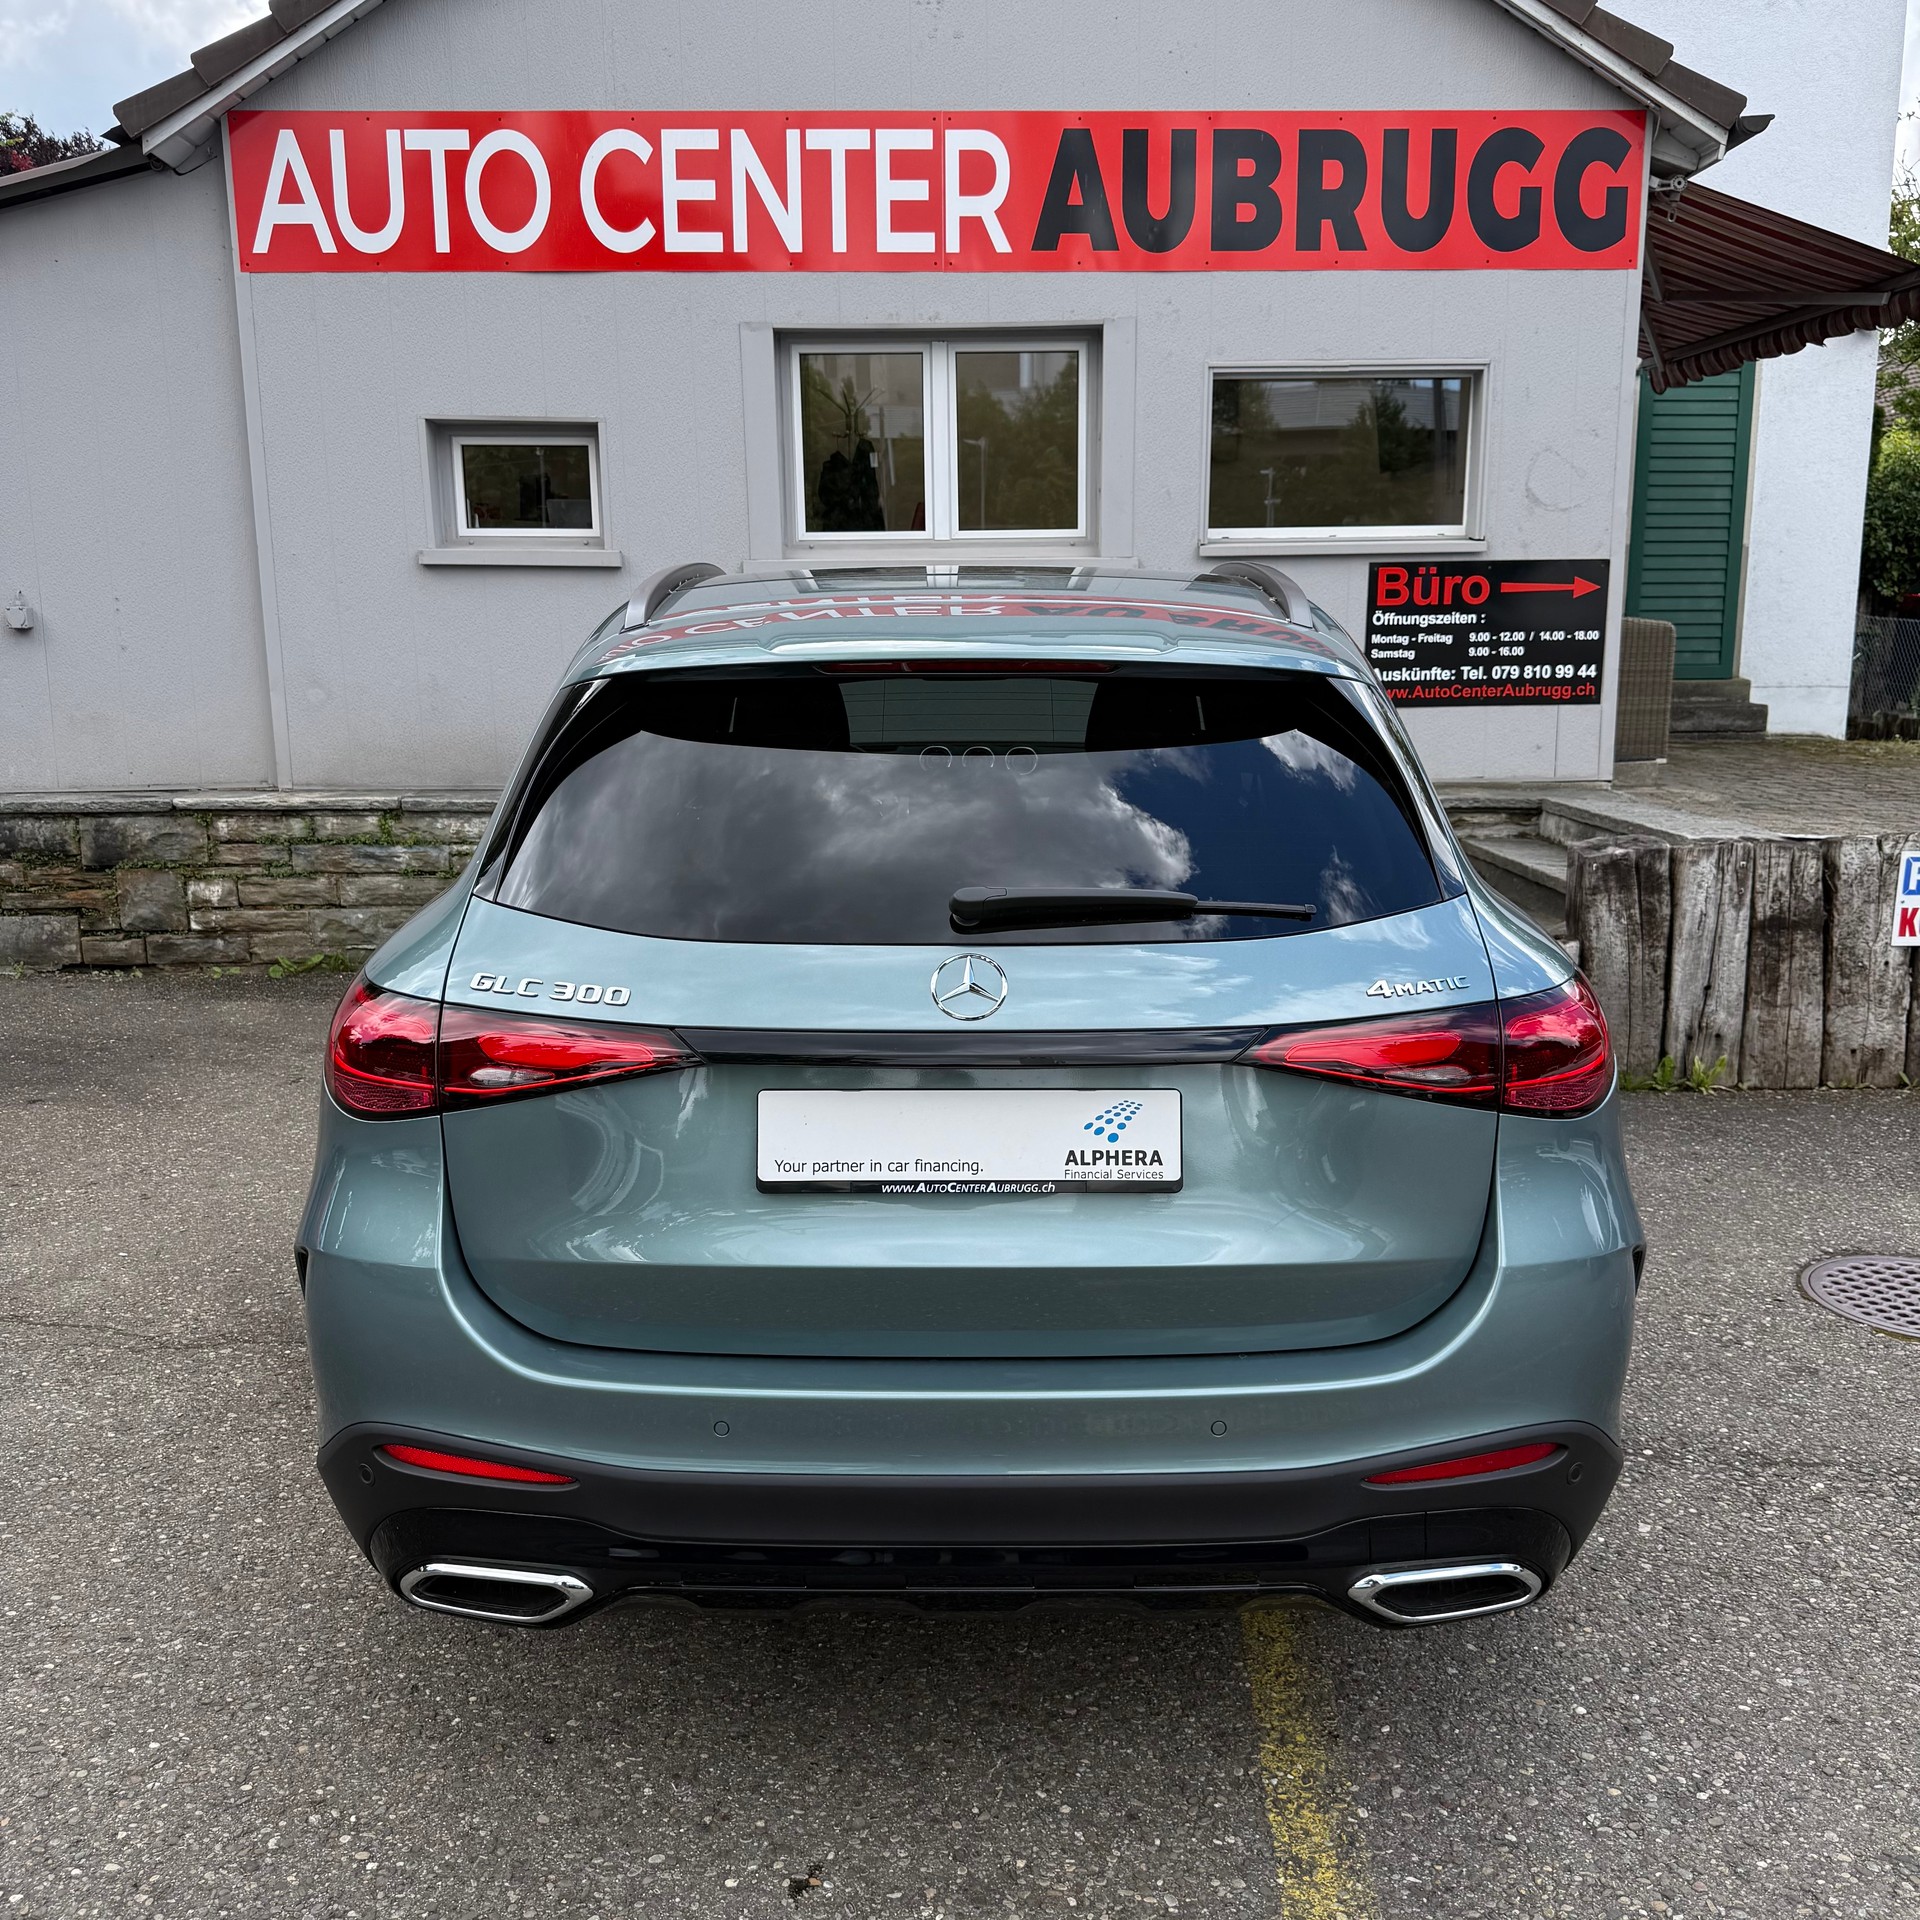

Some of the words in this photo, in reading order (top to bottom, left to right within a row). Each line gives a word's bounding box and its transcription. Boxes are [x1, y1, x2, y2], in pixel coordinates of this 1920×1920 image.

[252, 128, 551, 254] AUTO
[580, 128, 1012, 254] CENTER
[1031, 127, 1631, 253] AUBRUGG
[1376, 567, 1491, 606] Büro
[1372, 610, 1477, 628] Öffnungszeiten
[1371, 634, 1409, 646] Montag
[1417, 633, 1453, 645] Freitag
[1469, 632, 1490, 642] 9.00
[1499, 631, 1525, 641] 12.00
[1539, 631, 1565, 640] 14.00
[1574, 630, 1600, 640] 18.00
[1371, 649, 1415, 660] Samstag
[1468, 647, 1489, 656] 9.00
[1499, 646, 1525, 656] 16.00
[1460, 666, 1487, 680] Tel.
[1491, 665, 1520, 679] 079
[1523, 664, 1551, 679] 810
[1555, 664, 1574, 679] 99
[1577, 664, 1597, 678] 44
[1386, 682, 1596, 699] ww.AutoCenterAubrugg.ch
[1898, 907, 1920, 937] K
[470, 972, 543, 997] GLC
[549, 981, 631, 1006] 300
[1366, 975, 1471, 998] 4MATIC
[1064, 1150, 1164, 1166] ALPHERA
[775, 1160, 807, 1172] Your
[812, 1160, 865, 1175] partner
[870, 1159, 882, 1172] in
[888, 1162, 910, 1172] car
[915, 1159, 984, 1175] financing.
[1064, 1169, 1112, 1179] Financial
[1117, 1169, 1164, 1179] Services
